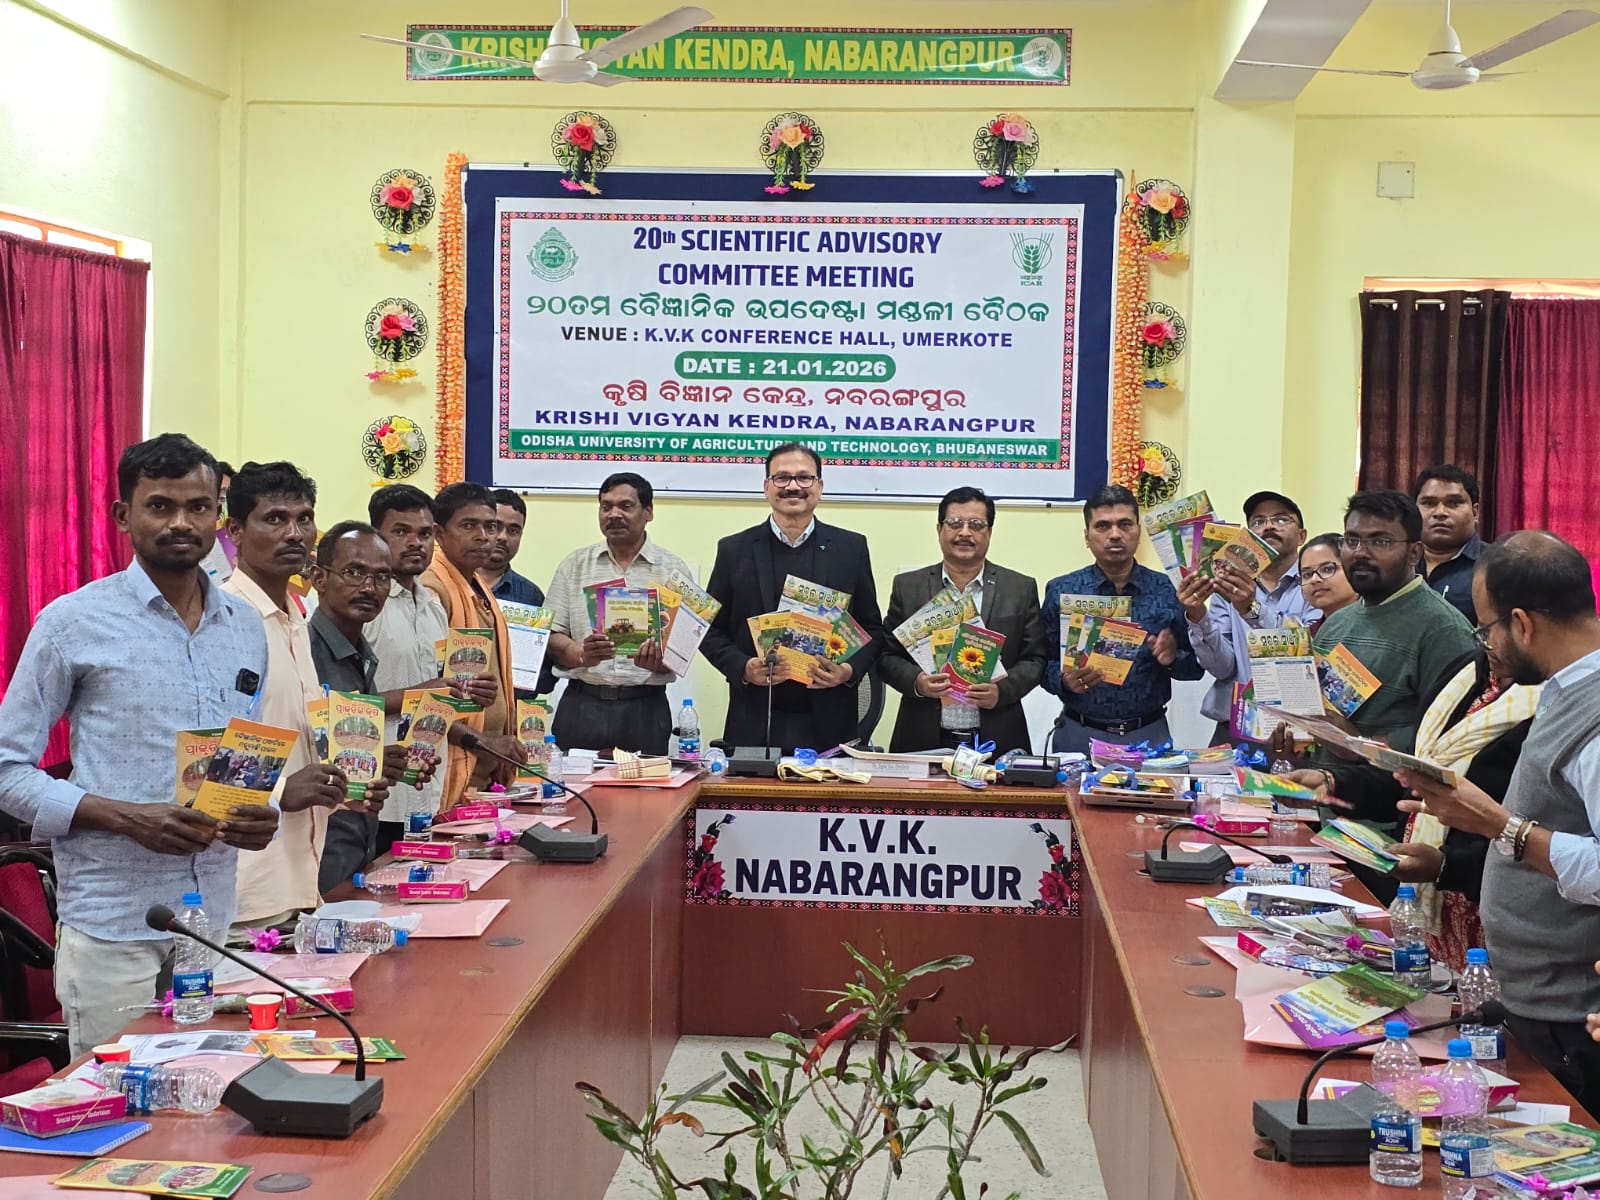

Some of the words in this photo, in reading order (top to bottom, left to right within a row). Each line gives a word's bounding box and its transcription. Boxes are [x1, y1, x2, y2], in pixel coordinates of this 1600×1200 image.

[461, 37, 550, 68] KRISH
[674, 38, 795, 77] KENDRA,
[805, 39, 1015, 73] NABARANGPUR
[633, 227, 676, 250] 20th
[681, 229, 810, 252] SCIENTIFIC
[817, 231, 942, 254] ADVISORY
[658, 263, 799, 287] COMMITTEE
[806, 266, 914, 288] MEETING
[527, 295, 610, 316] ୨୦ତମ
[620, 291, 735, 318] ବୈଜ୍ଞାନିକ
[745, 299, 865, 322] ଉପଦେଷ୍ଟା
[876, 301, 953, 322] ମଣ୍ଡଳୀ
[964, 296, 1050, 322] ବୈଠକ
[561, 327, 627, 341] VENUE
[645, 328, 695, 343] K.V.K
[701, 329, 833, 345] CONFERENCE
[840, 331, 896, 349] HALL,
[902, 332, 1013, 348] UMERKOTE
[683, 358, 741, 374] DATE
[763, 360, 887, 376] 21.01.2026
[602, 379, 647, 407] କୃଷି
[659, 380, 733, 403] ବିଜ୍ଞାନ
[824, 387, 966, 411] ନବରଙ୍ଗପୁର
[535, 410, 619, 425] KRISHI
[628, 412, 719, 427] VIGYAN
[728, 414, 836, 432] KENDRA,
[845, 416, 1035, 433] NABARANGPUR
[521, 435, 575, 447] ODISHA
[579, 436, 665, 449] UNIVERSITY
[670, 438, 689, 449] OF
[831, 441, 931, 455] TECHNOLOGY,
[936, 443, 1048, 456] BHUBANESWAR
[819, 817, 937, 855] K.V.K.
[735, 858, 1022, 901] NABARANGPUR
[1378, 1126, 1407, 1138] TRUSHNA
